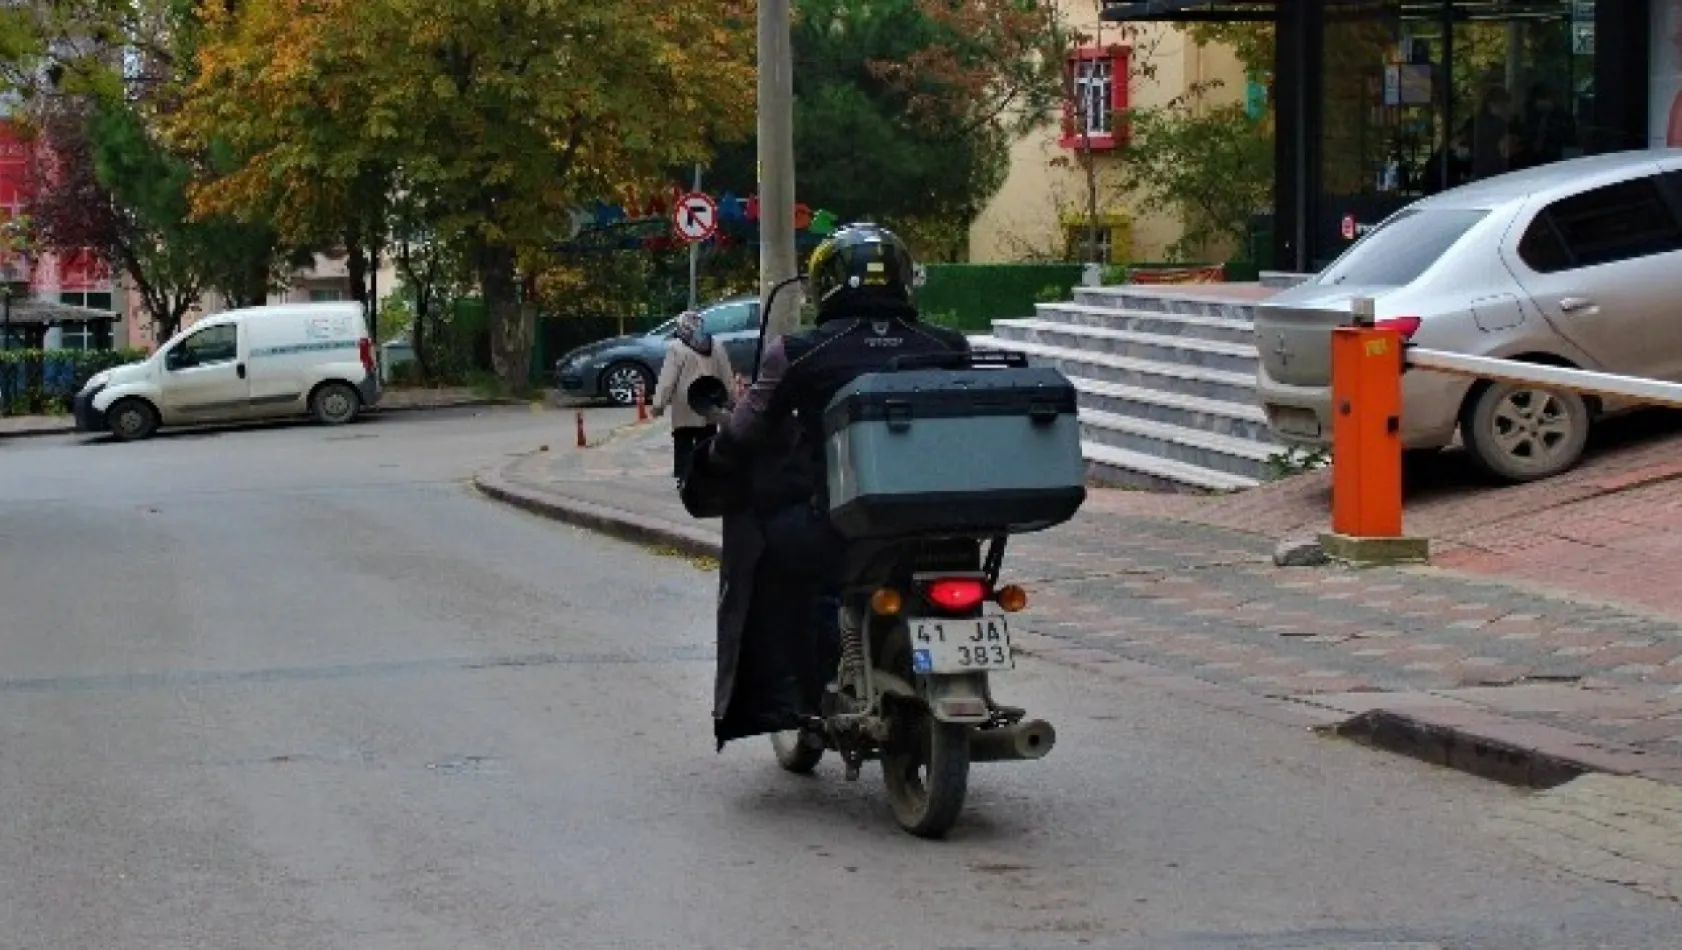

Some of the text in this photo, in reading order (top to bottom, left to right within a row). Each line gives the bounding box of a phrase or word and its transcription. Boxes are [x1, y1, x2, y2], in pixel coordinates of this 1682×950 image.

[917, 622, 1000, 644] 41 JA
[957, 645, 1005, 666] 383
